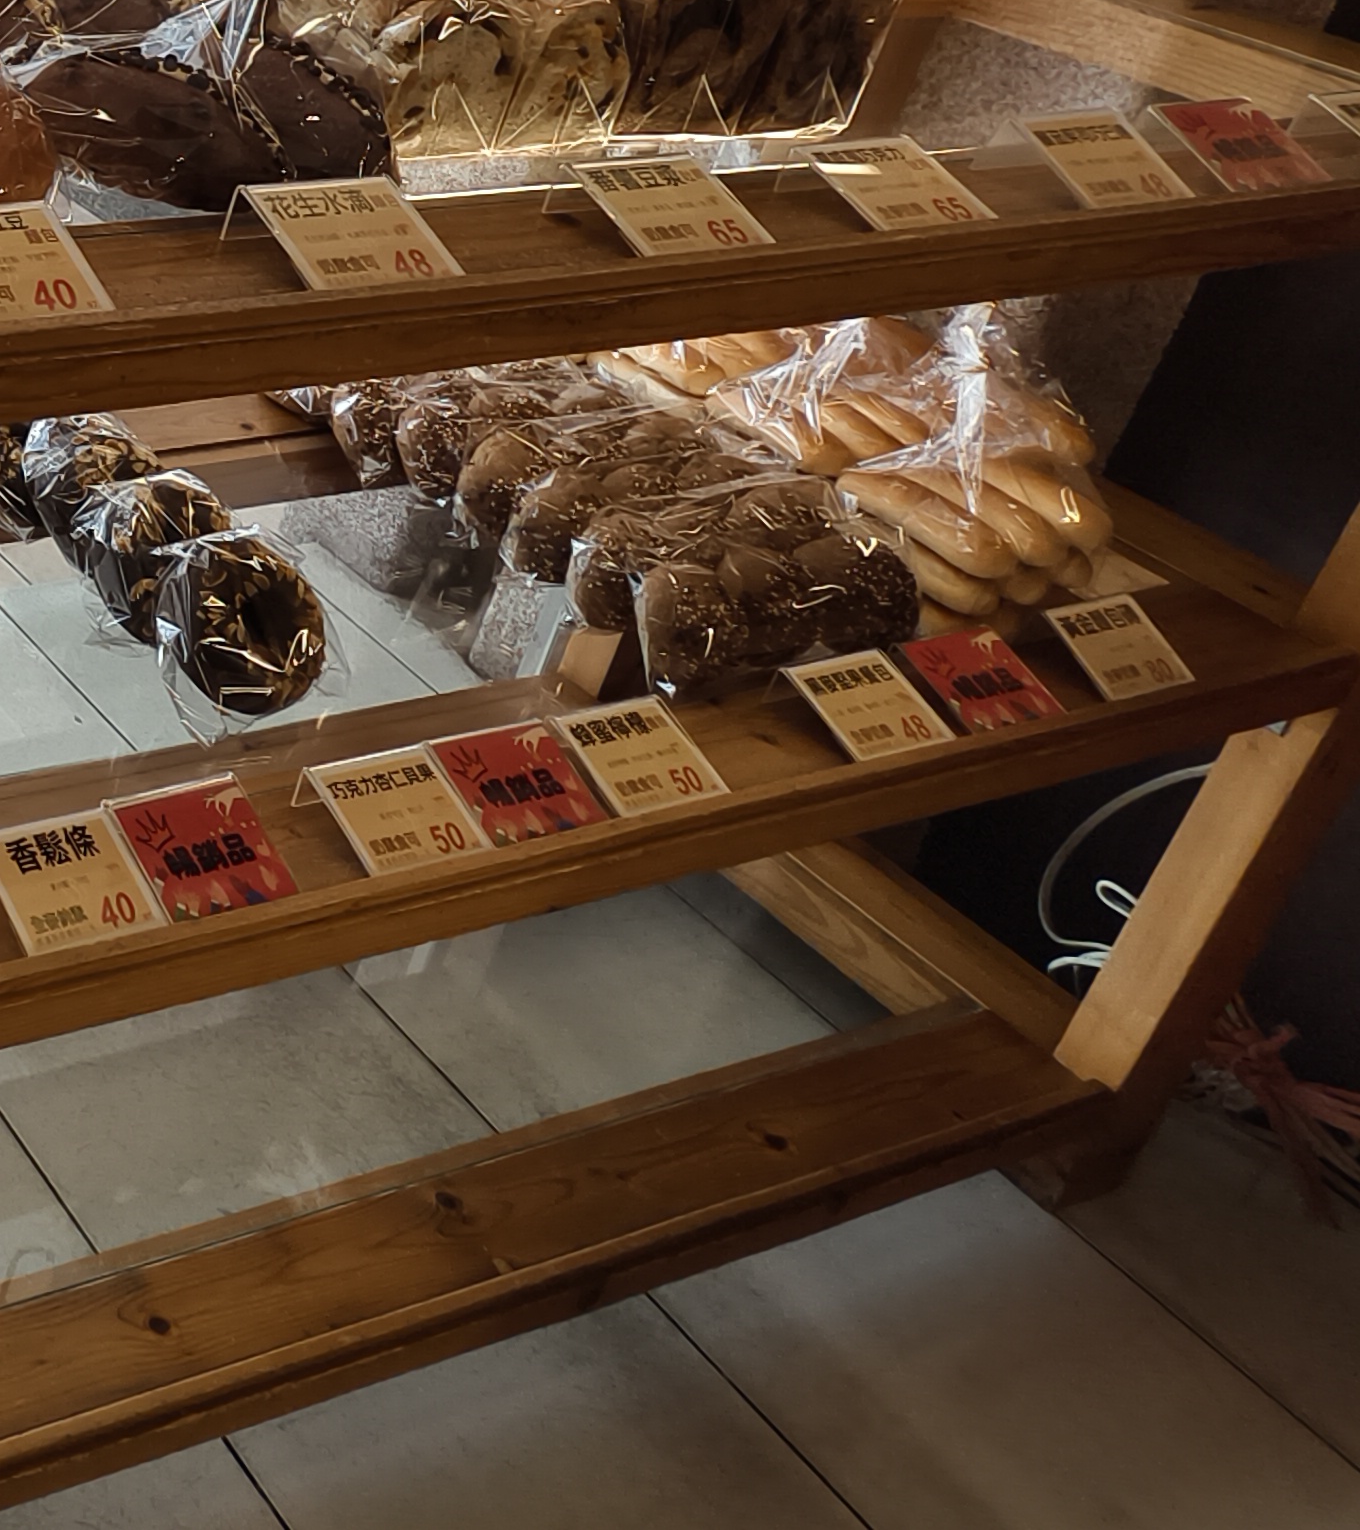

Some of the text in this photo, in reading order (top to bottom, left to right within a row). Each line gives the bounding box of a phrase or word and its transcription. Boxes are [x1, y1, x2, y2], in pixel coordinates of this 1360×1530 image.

[1139, 172, 1172, 197] 48
[931, 197, 973, 221] 65
[707, 219, 749, 246] 65
[394, 248, 434, 279] 48
[34, 278, 78, 311] 40
[900, 714, 932, 743] 48
[326, 763, 437, 801] 巧克力杏仁貝果
[668, 765, 703, 796] 50
[5, 824, 101, 875] 香鬆條
[429, 821, 466, 855] 50
[163, 833, 257, 880] 暢銷品
[100, 891, 136, 929] 40
